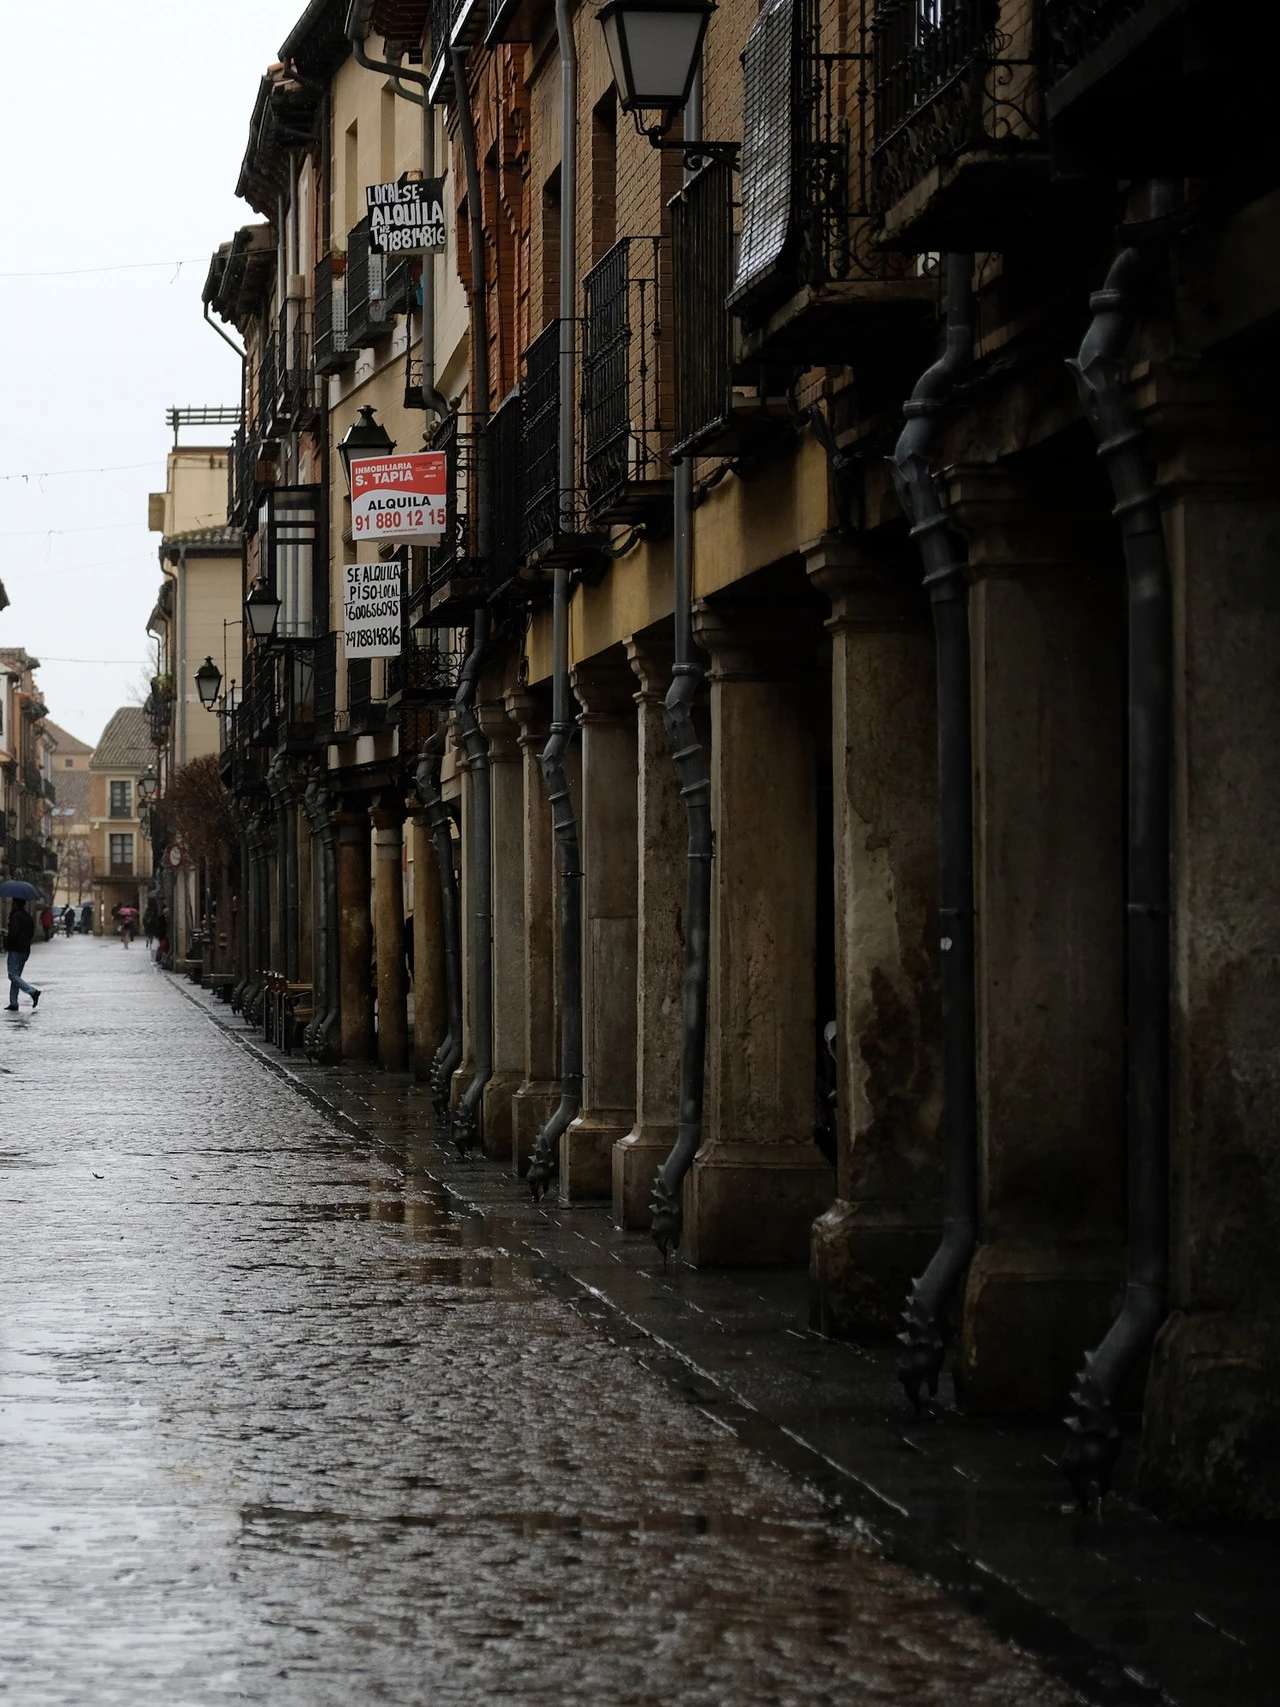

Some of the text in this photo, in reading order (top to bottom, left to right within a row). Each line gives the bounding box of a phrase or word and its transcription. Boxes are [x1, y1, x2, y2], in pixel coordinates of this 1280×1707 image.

[372, 199, 444, 226] ALQUILA
[355, 462, 412, 475] INMOBILIARIA
[355, 470, 414, 487] S. TAPIA
[368, 496, 432, 511] ALQUILA
[355, 509, 446, 531] 91 880 12 15
[348, 600, 399, 621] 600656095
